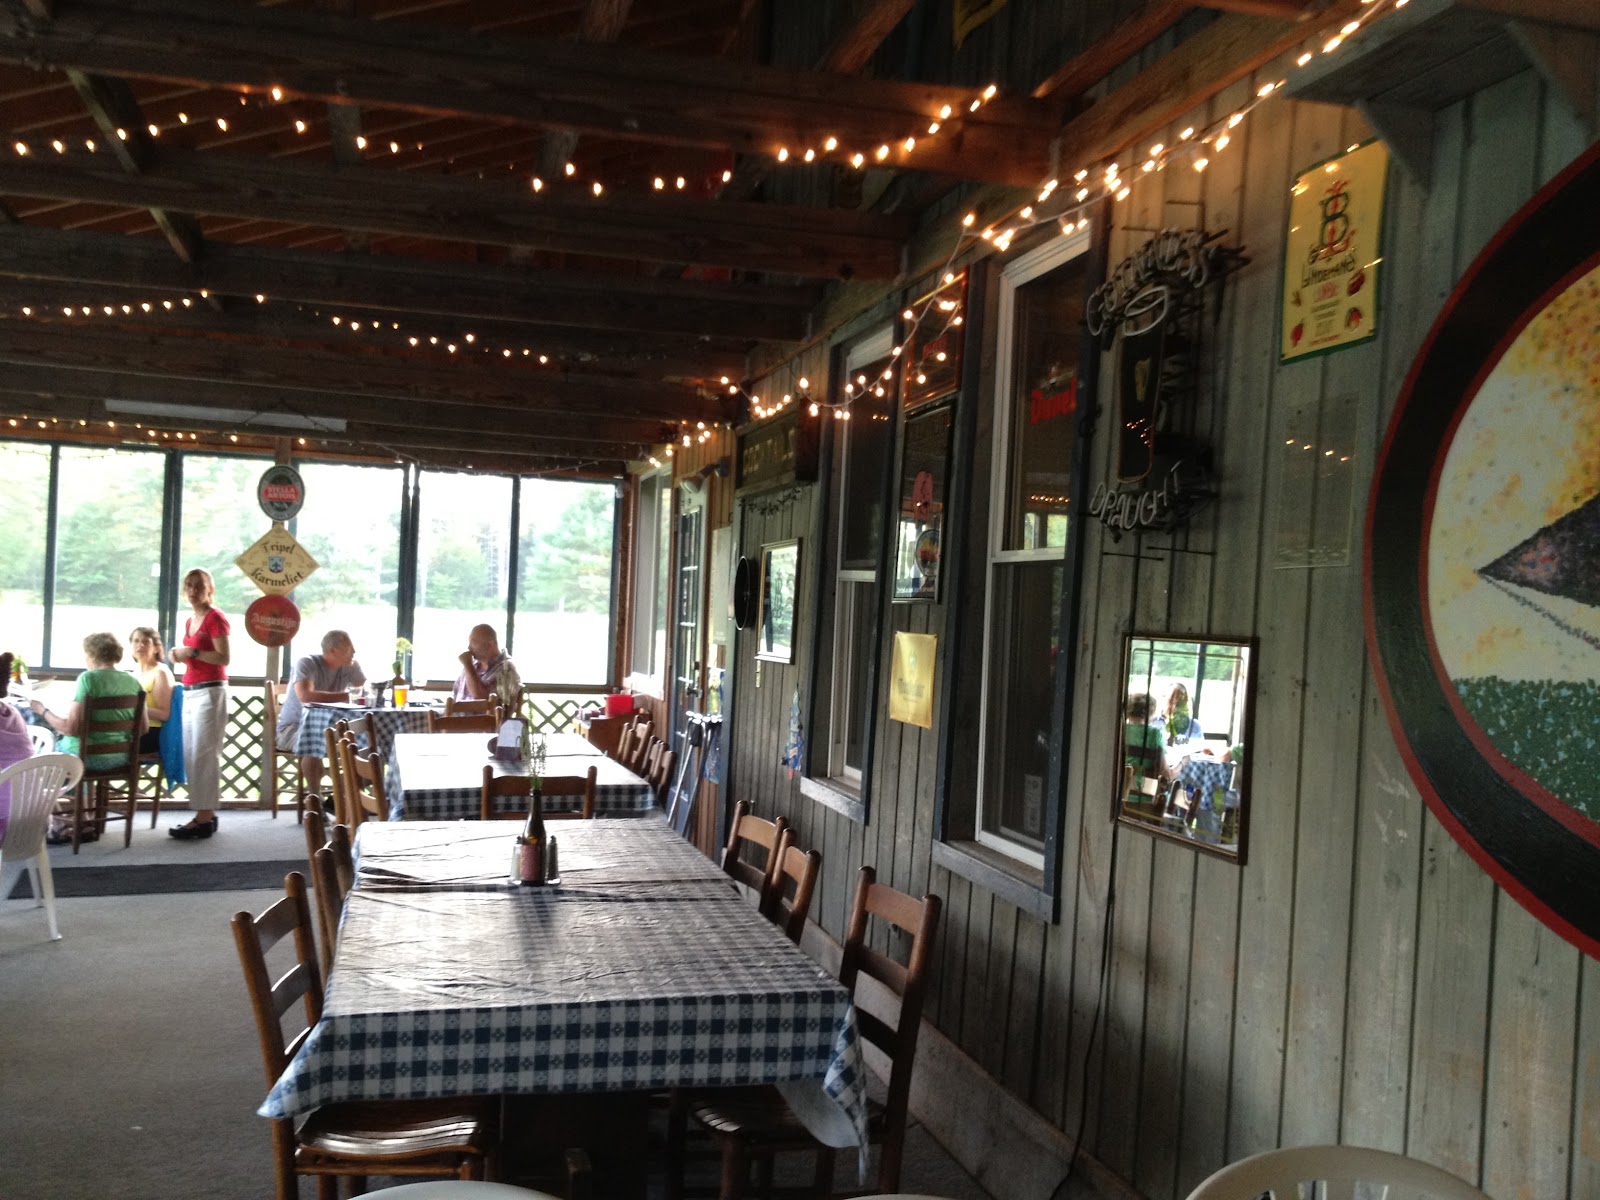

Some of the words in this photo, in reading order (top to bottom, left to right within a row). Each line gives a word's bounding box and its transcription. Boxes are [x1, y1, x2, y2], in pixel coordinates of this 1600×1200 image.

[1089, 460, 1183, 530] DRAUGHT
[261, 541, 296, 555] Tripel
[251, 567, 304, 587] Karmeliet
